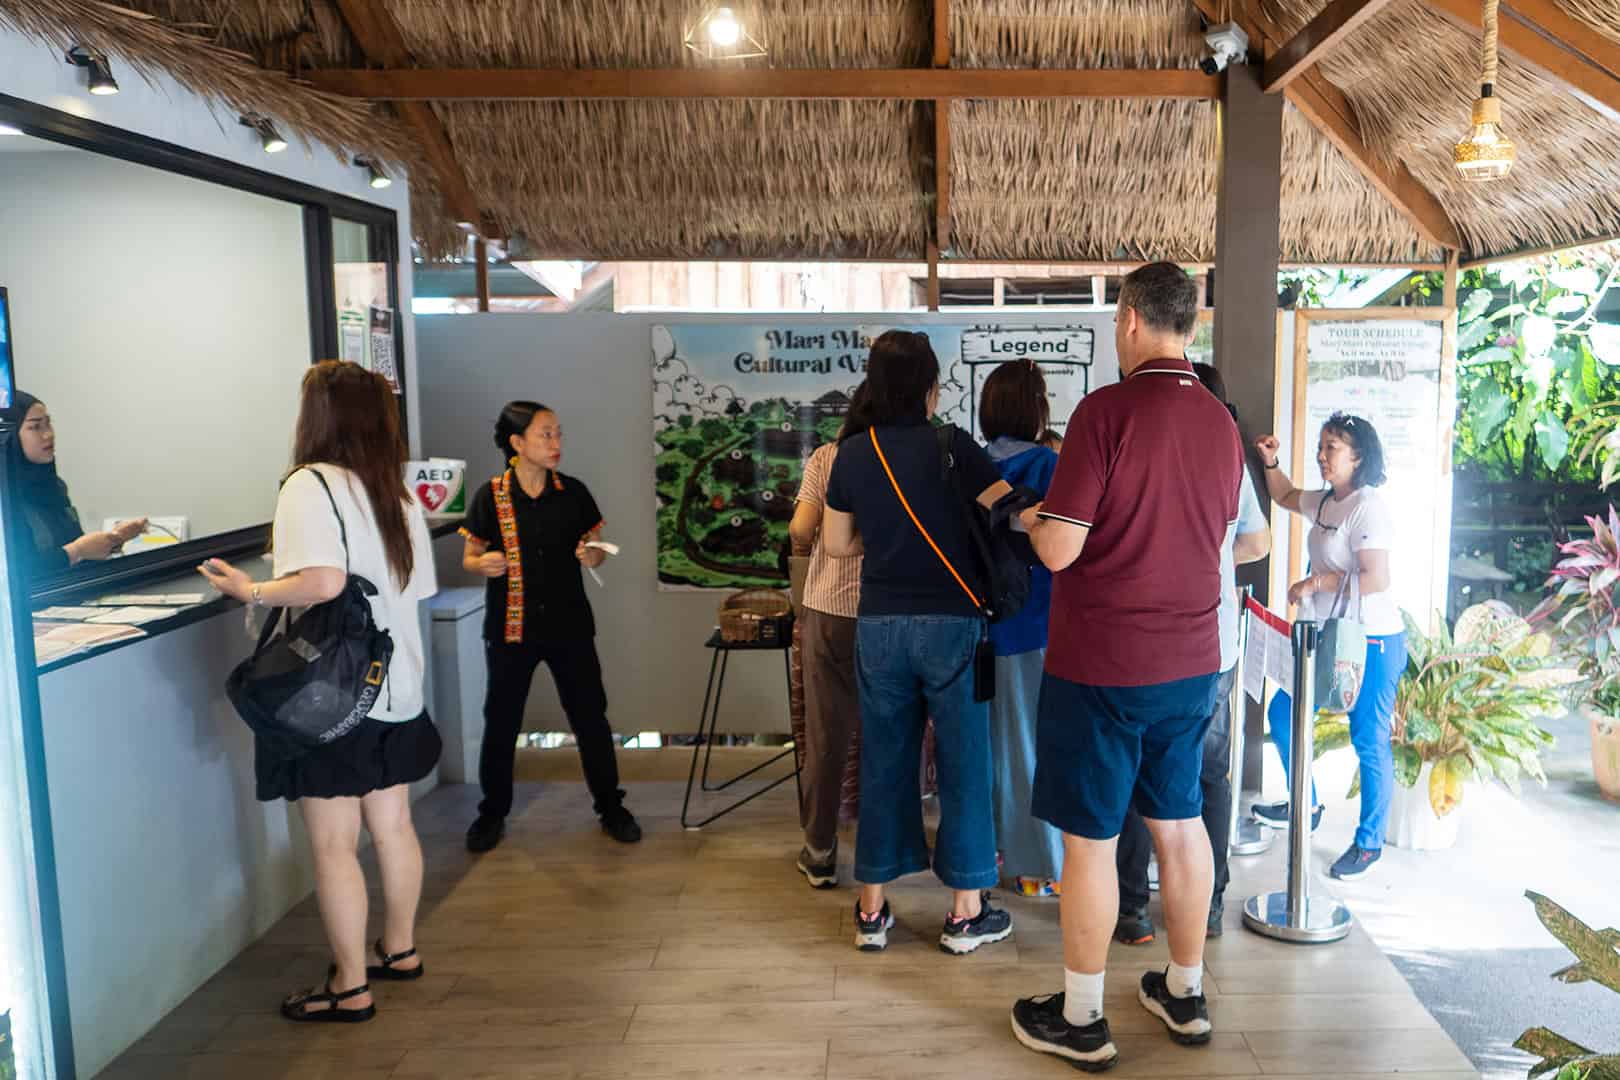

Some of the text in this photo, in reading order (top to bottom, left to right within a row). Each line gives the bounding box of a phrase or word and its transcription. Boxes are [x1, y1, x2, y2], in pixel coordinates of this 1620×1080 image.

[765, 325, 869, 350] Mari Ma
[1327, 327, 1425, 337] TOUR SCHEDULE
[990, 339, 1068, 356] Legend
[734, 352, 869, 374] Cultural Vi
[416, 469, 453, 481] AED
